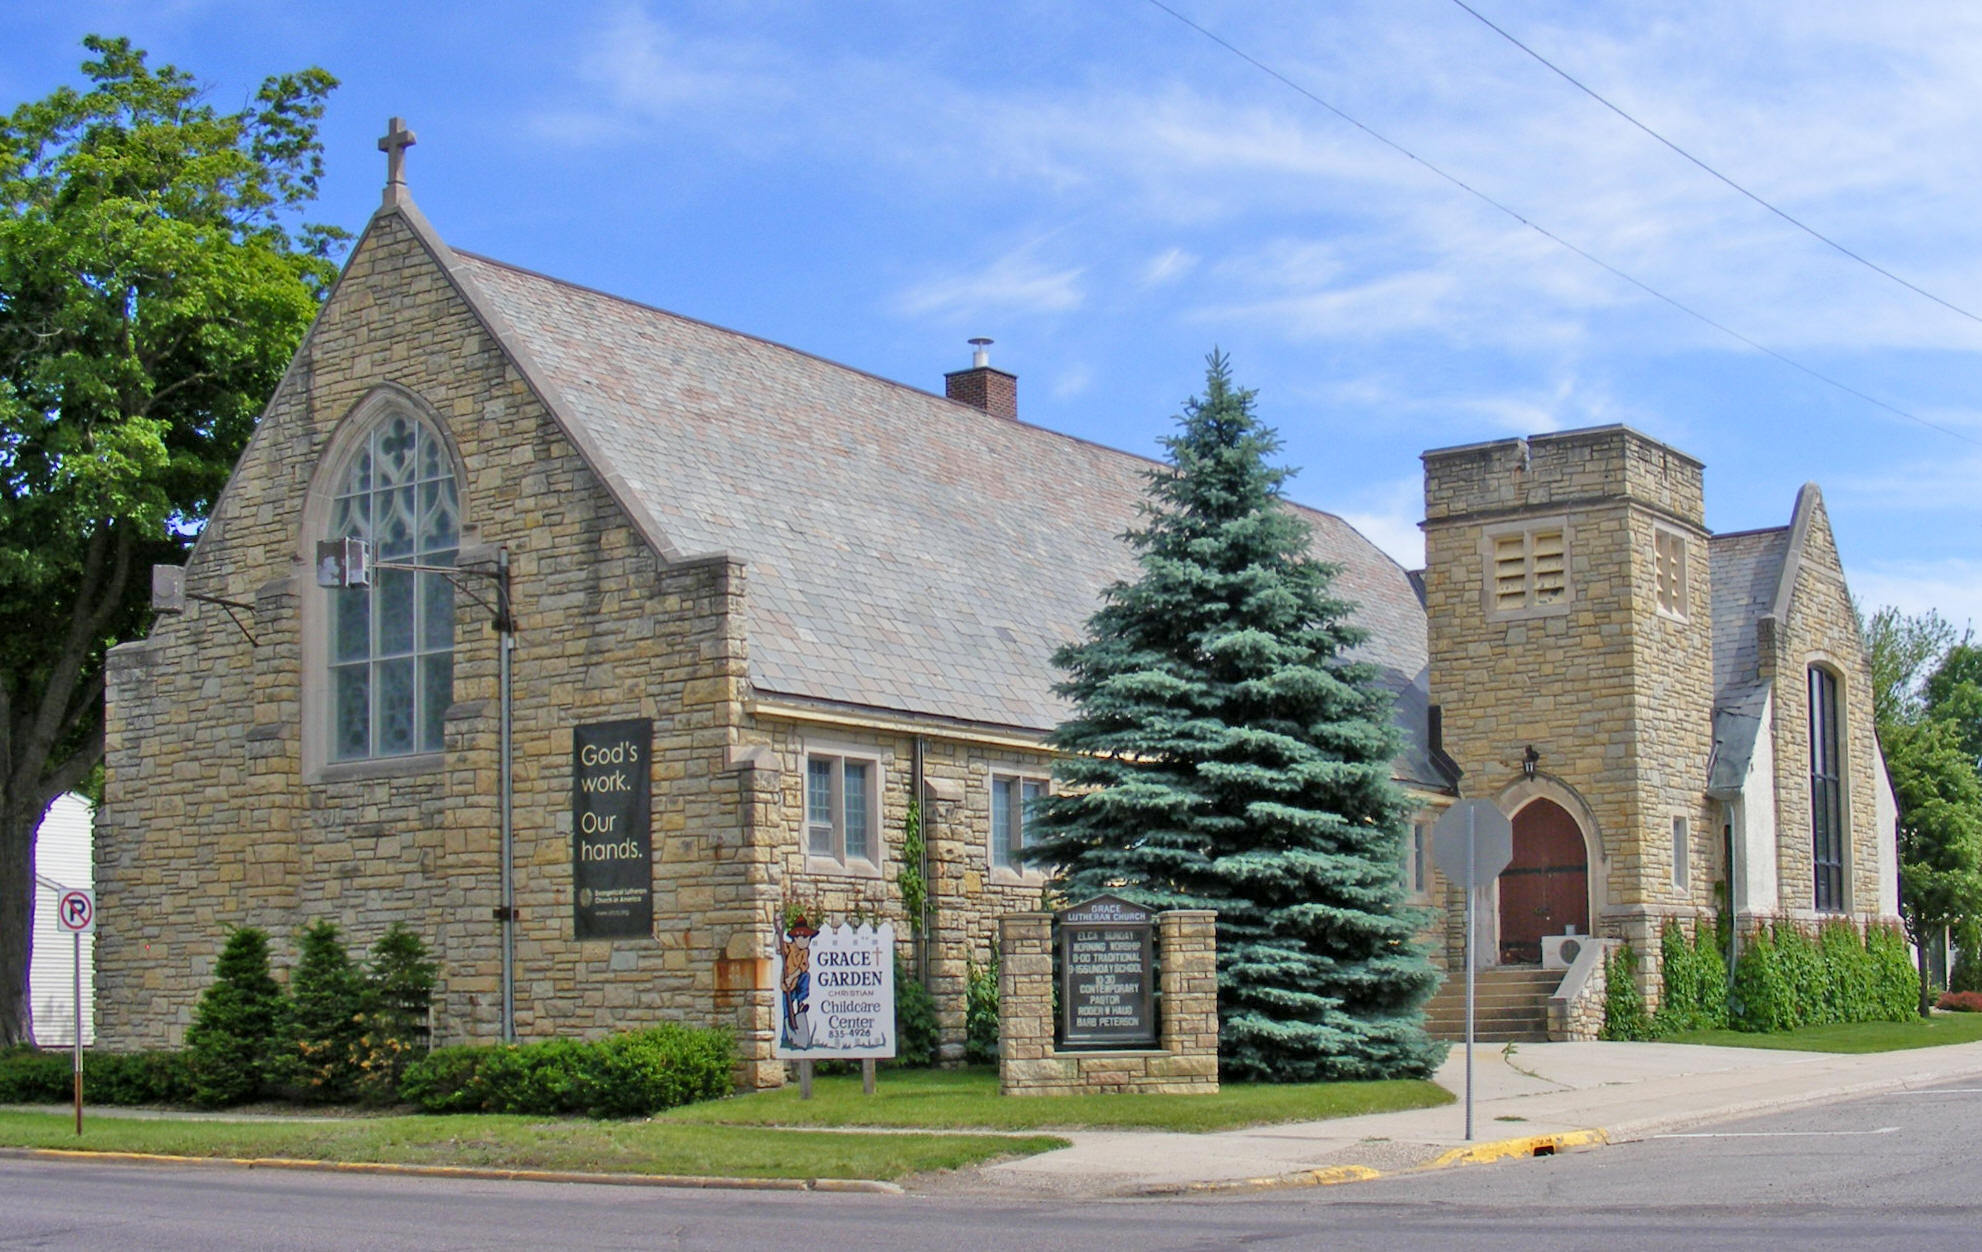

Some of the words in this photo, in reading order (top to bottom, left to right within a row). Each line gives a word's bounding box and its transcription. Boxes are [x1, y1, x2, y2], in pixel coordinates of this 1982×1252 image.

[581, 741, 638, 767] God's
[581, 770, 631, 793] work.
[581, 811, 616, 834] Our
[581, 838, 643, 861] hands.
[69, 899, 86, 921] P
[1091, 904, 1121, 913] GRACE
[1067, 912, 1111, 921] LUTHERAN
[1113, 912, 1146, 921] CHURCH
[1073, 942, 1106, 952] MORNING
[1110, 941, 1142, 951] WORSHIP
[817, 951, 871, 967] GRACE
[1093, 952, 1142, 962] TRADITIONAL
[818, 971, 883, 987] GARDEN
[1079, 984, 1139, 994] CONTEMPORARY
[820, 1000, 881, 1013] Childcare
[1090, 995, 1120, 1005] PASTOR
[828, 1015, 875, 1029] Center
[1099, 1016, 1139, 1026] PETERSON
